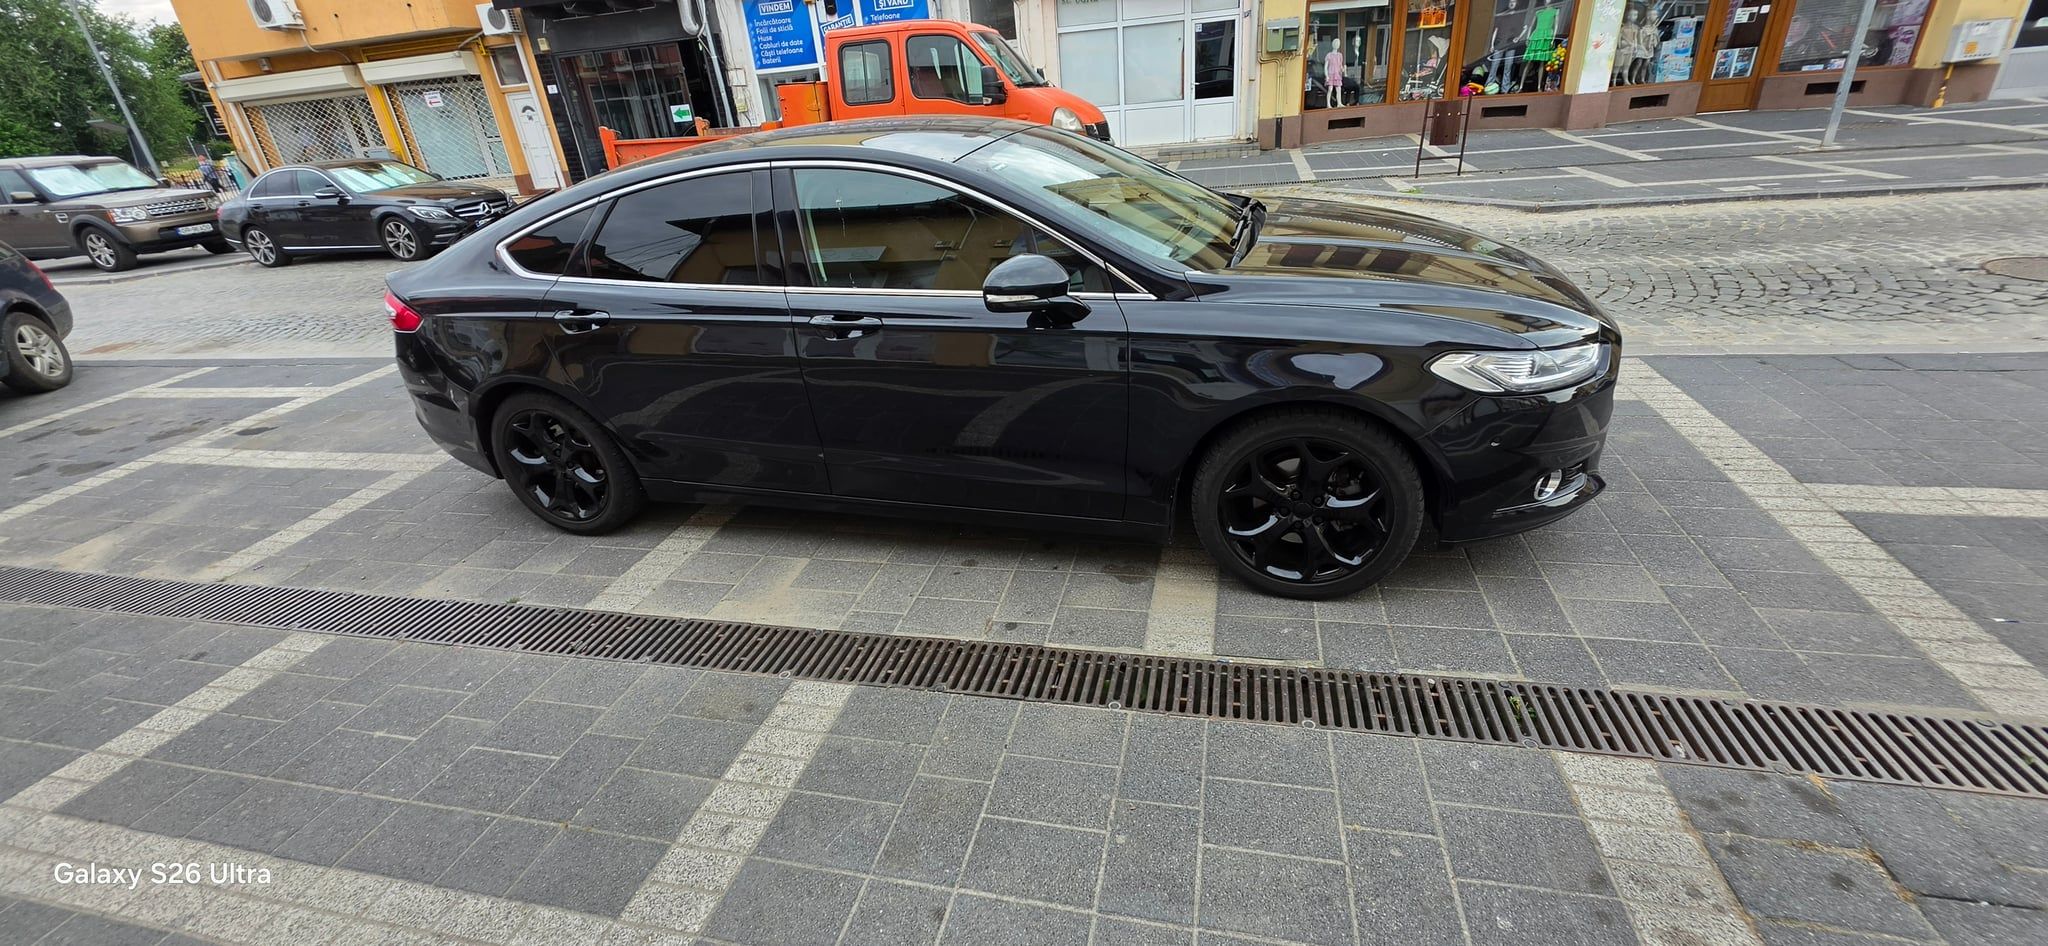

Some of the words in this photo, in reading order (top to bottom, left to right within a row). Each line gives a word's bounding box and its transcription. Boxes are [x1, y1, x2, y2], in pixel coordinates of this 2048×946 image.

[760, 3, 790, 13] VINDEM
[870, 13, 900, 21] Telefoane
[754, 17, 791, 27] Încărcătoare
[756, 27, 768, 35] Folii
[778, 24, 793, 32] sticlă
[759, 41, 780, 50] Cabluri
[777, 48, 803, 56] telefoane
[762, 57, 781, 65] Baterii
